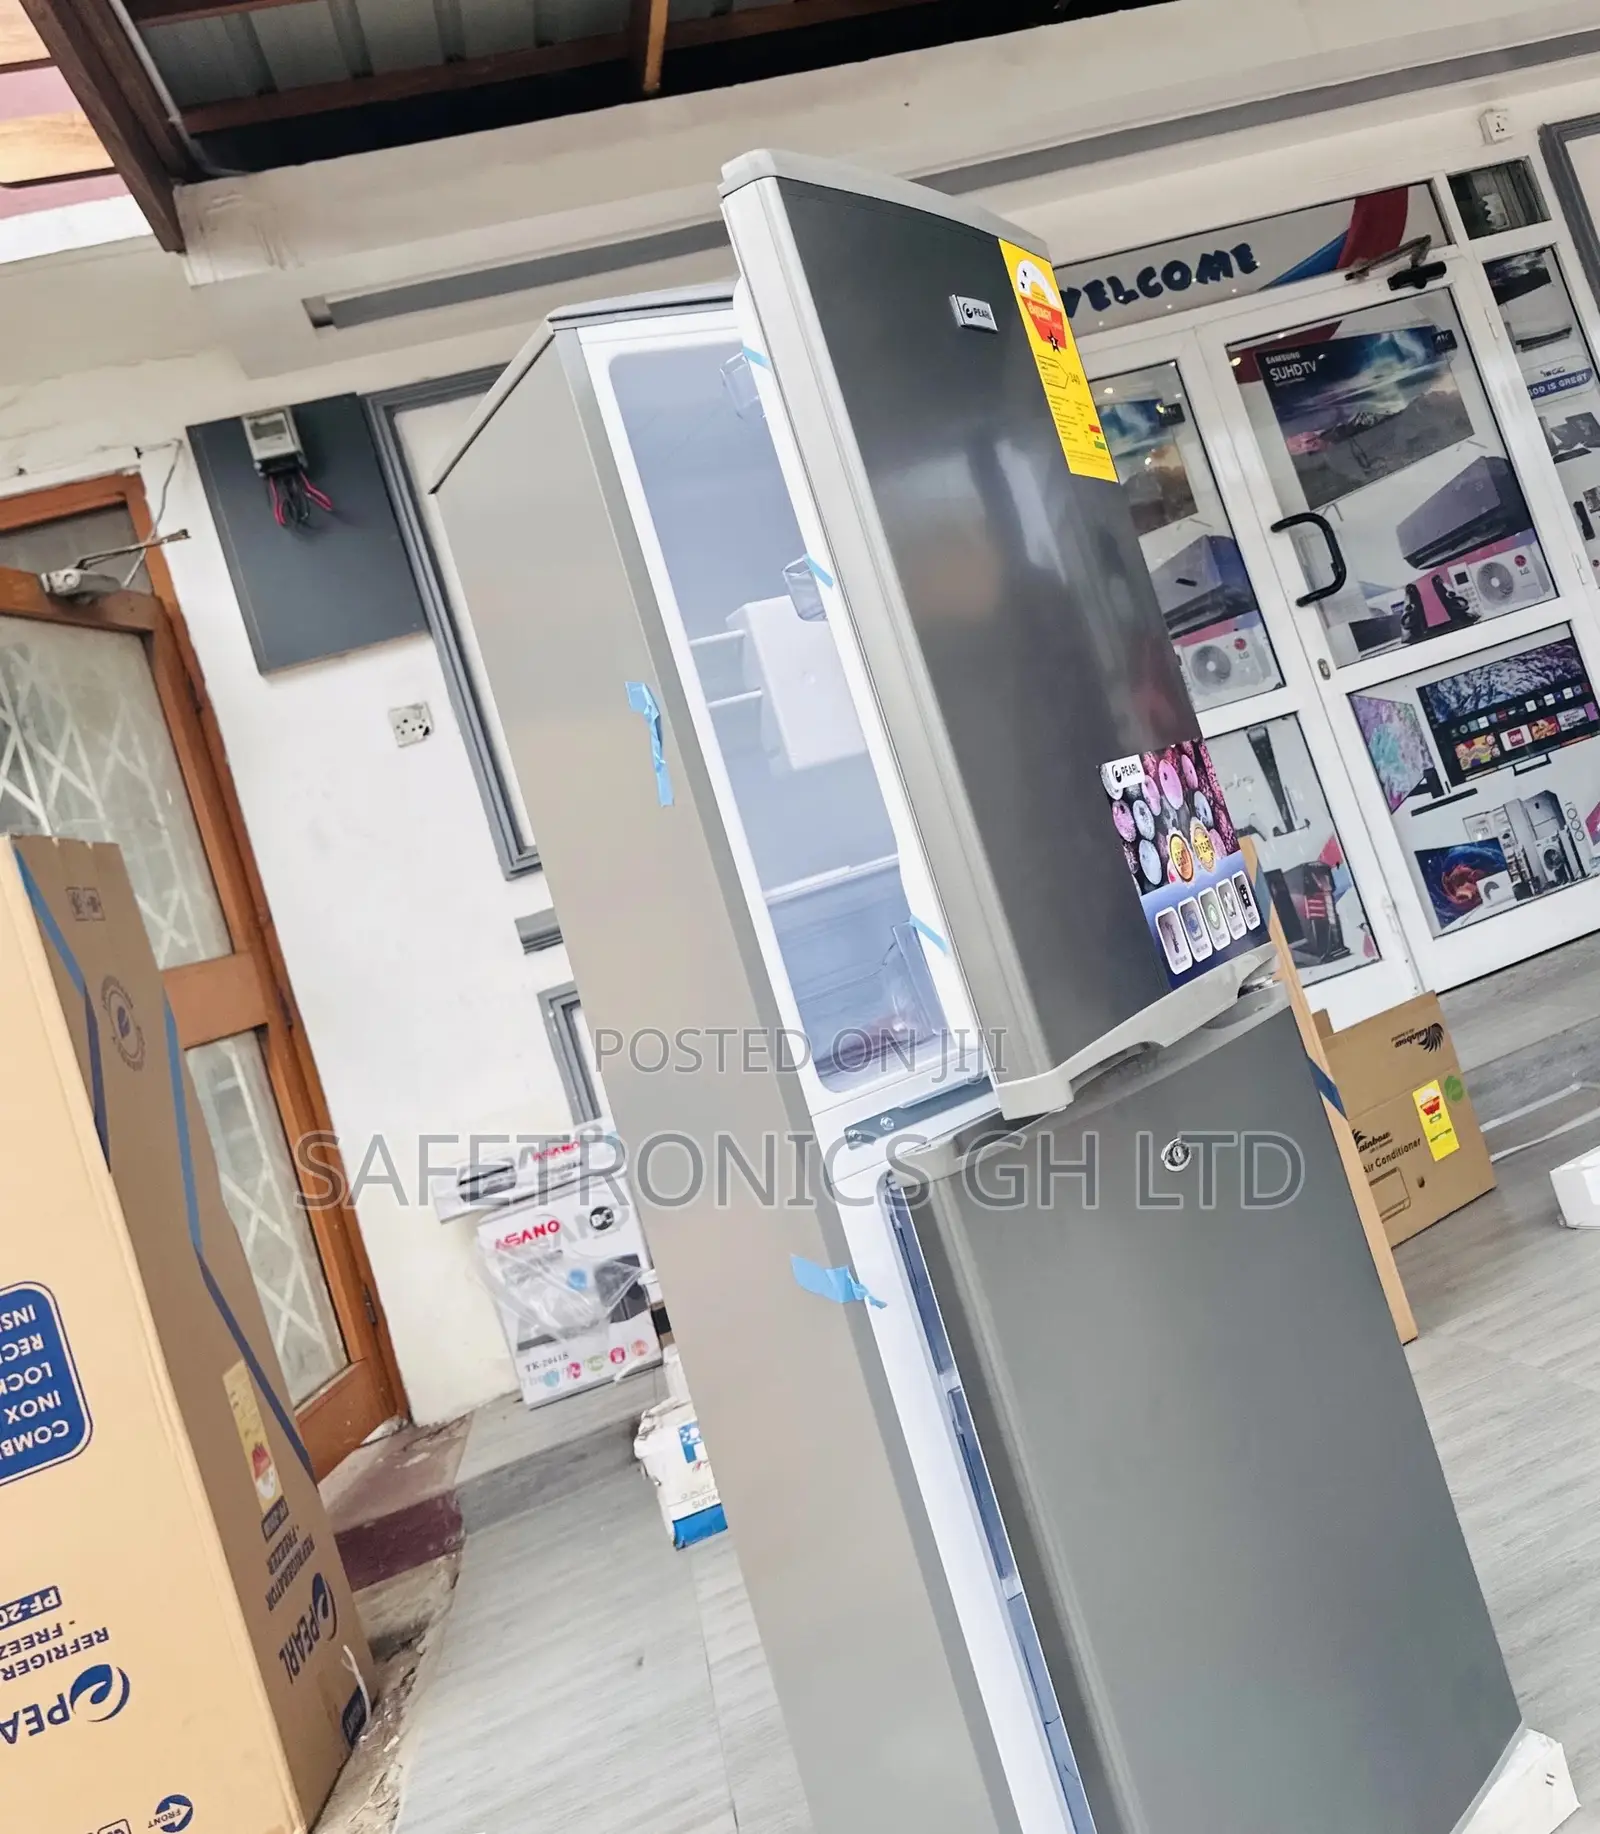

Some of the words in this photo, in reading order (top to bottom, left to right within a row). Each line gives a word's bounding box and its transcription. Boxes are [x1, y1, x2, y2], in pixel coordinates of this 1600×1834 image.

[1547, 382, 1557, 391] IS
[1121, 763, 1140, 776] PEARL
[1375, 1138, 1421, 1168] Conditioner
[495, 1219, 561, 1250] ASANO
[4, 1389, 62, 1425] INOX
[278, 1603, 321, 1685] PEARL
[147, 1808, 181, 1829] FRONT
